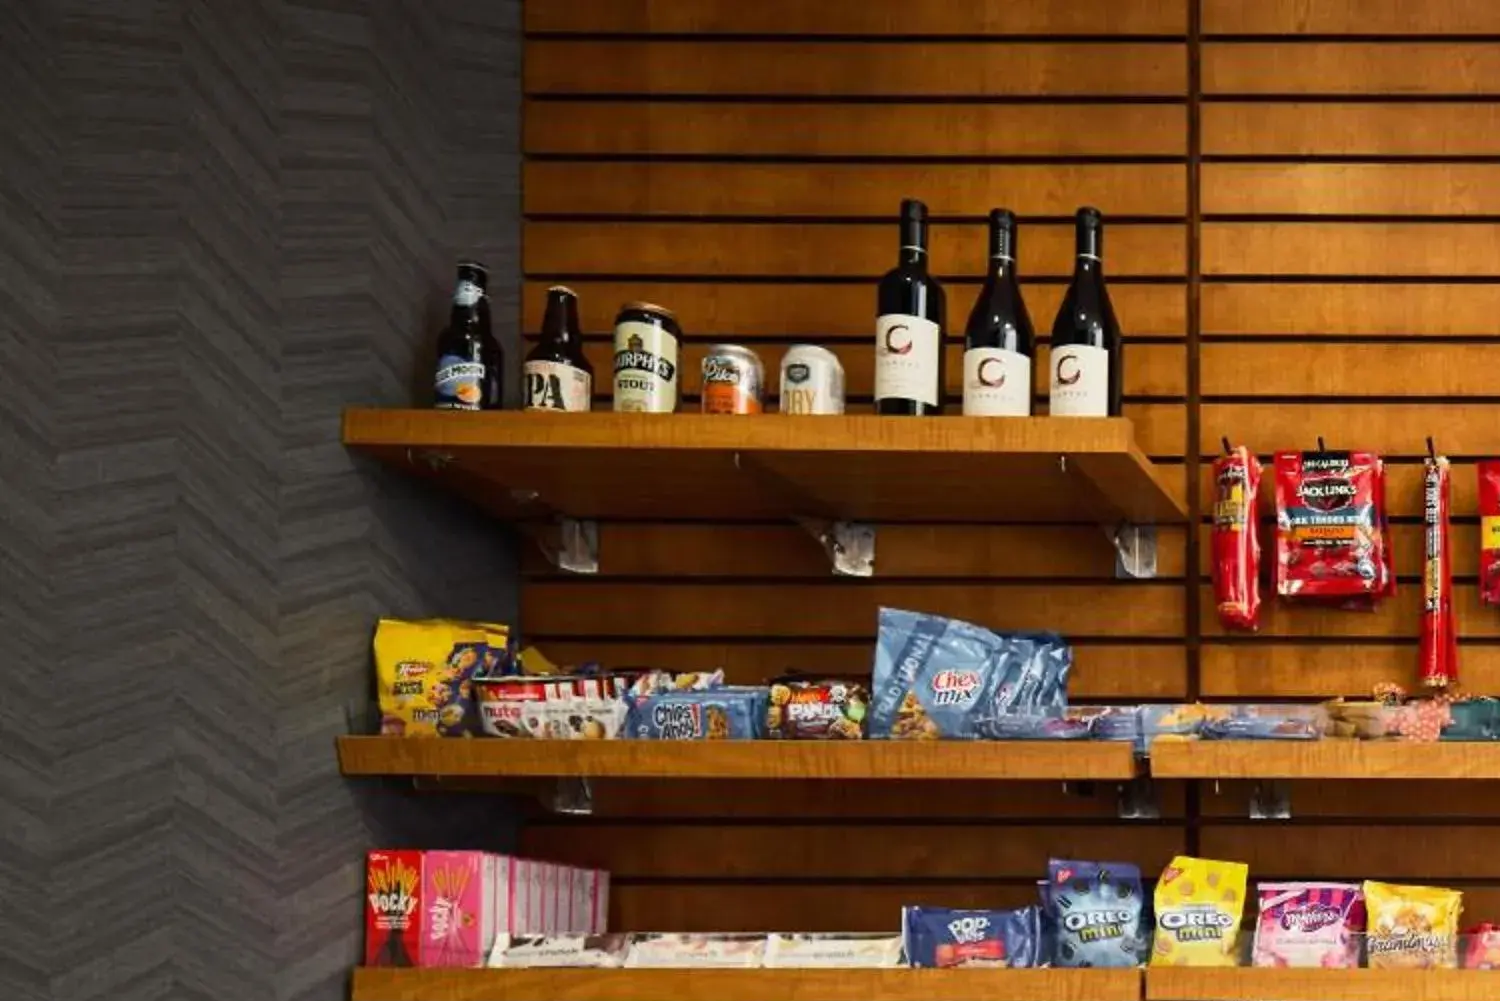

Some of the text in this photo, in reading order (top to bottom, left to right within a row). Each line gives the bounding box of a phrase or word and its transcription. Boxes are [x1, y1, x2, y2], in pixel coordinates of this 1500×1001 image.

[1297, 484, 1324, 497] JACK
[932, 671, 980, 690] Chex
[654, 704, 692, 725] Chips
[370, 894, 418, 915] POCKY
[1066, 910, 1132, 930] OREO
[1160, 911, 1234, 929] OREO
